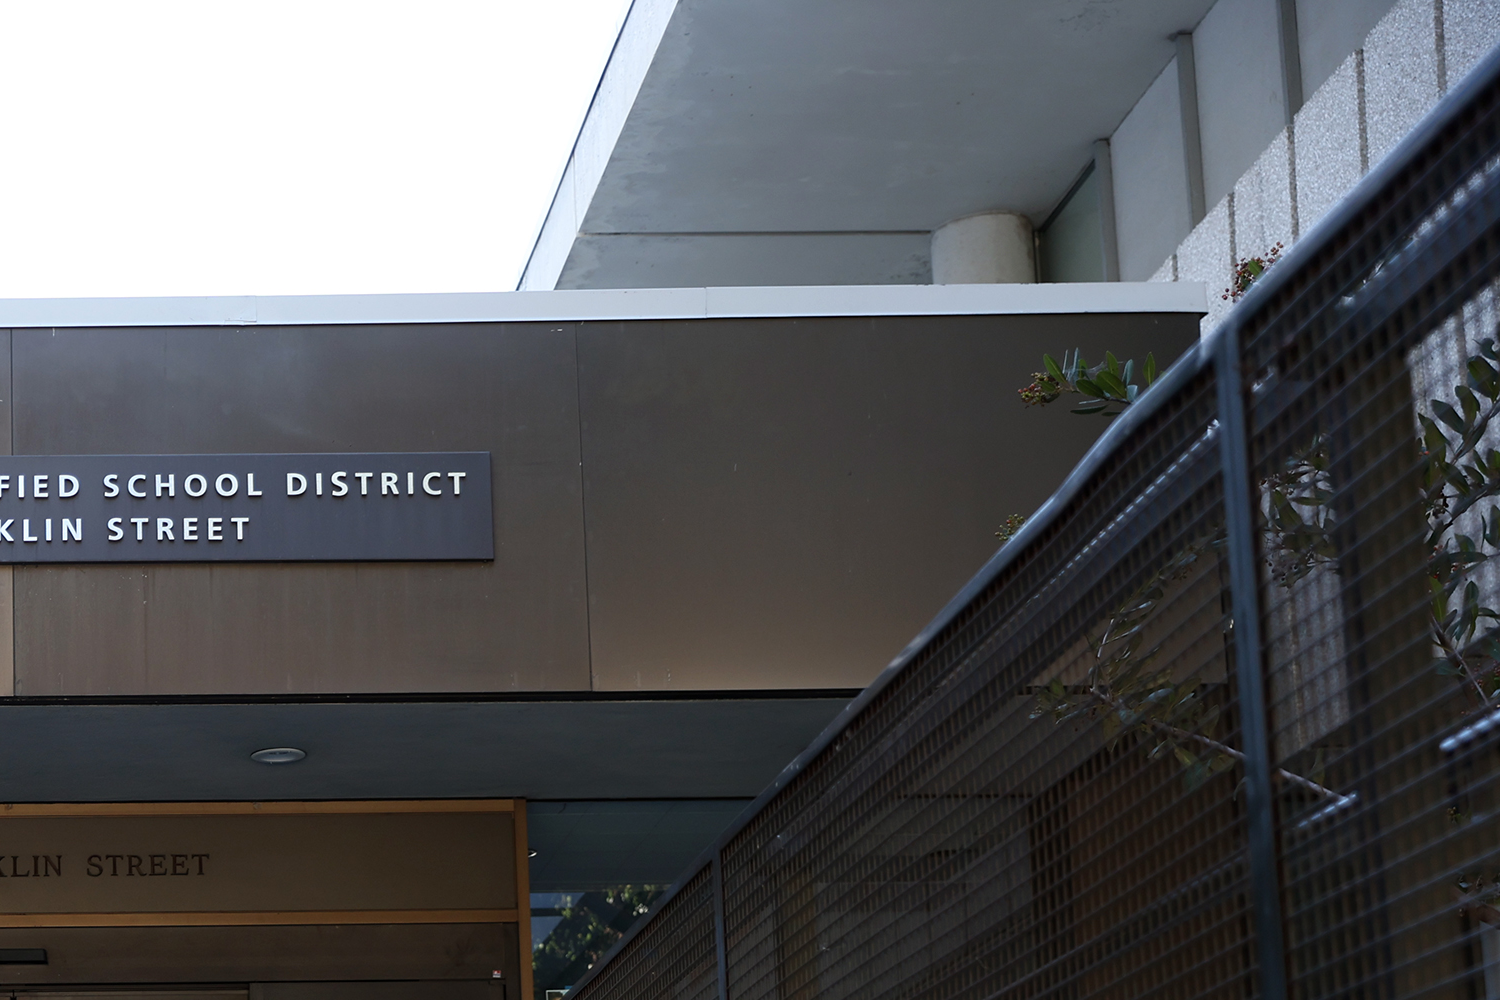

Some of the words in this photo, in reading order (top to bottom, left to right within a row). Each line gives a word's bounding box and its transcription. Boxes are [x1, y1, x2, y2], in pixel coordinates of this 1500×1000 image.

[103, 472, 263, 499] SCHOOL
[286, 471, 467, 497] DISTRICT
[107, 516, 251, 542] STREET
[86, 852, 211, 878] STREET
